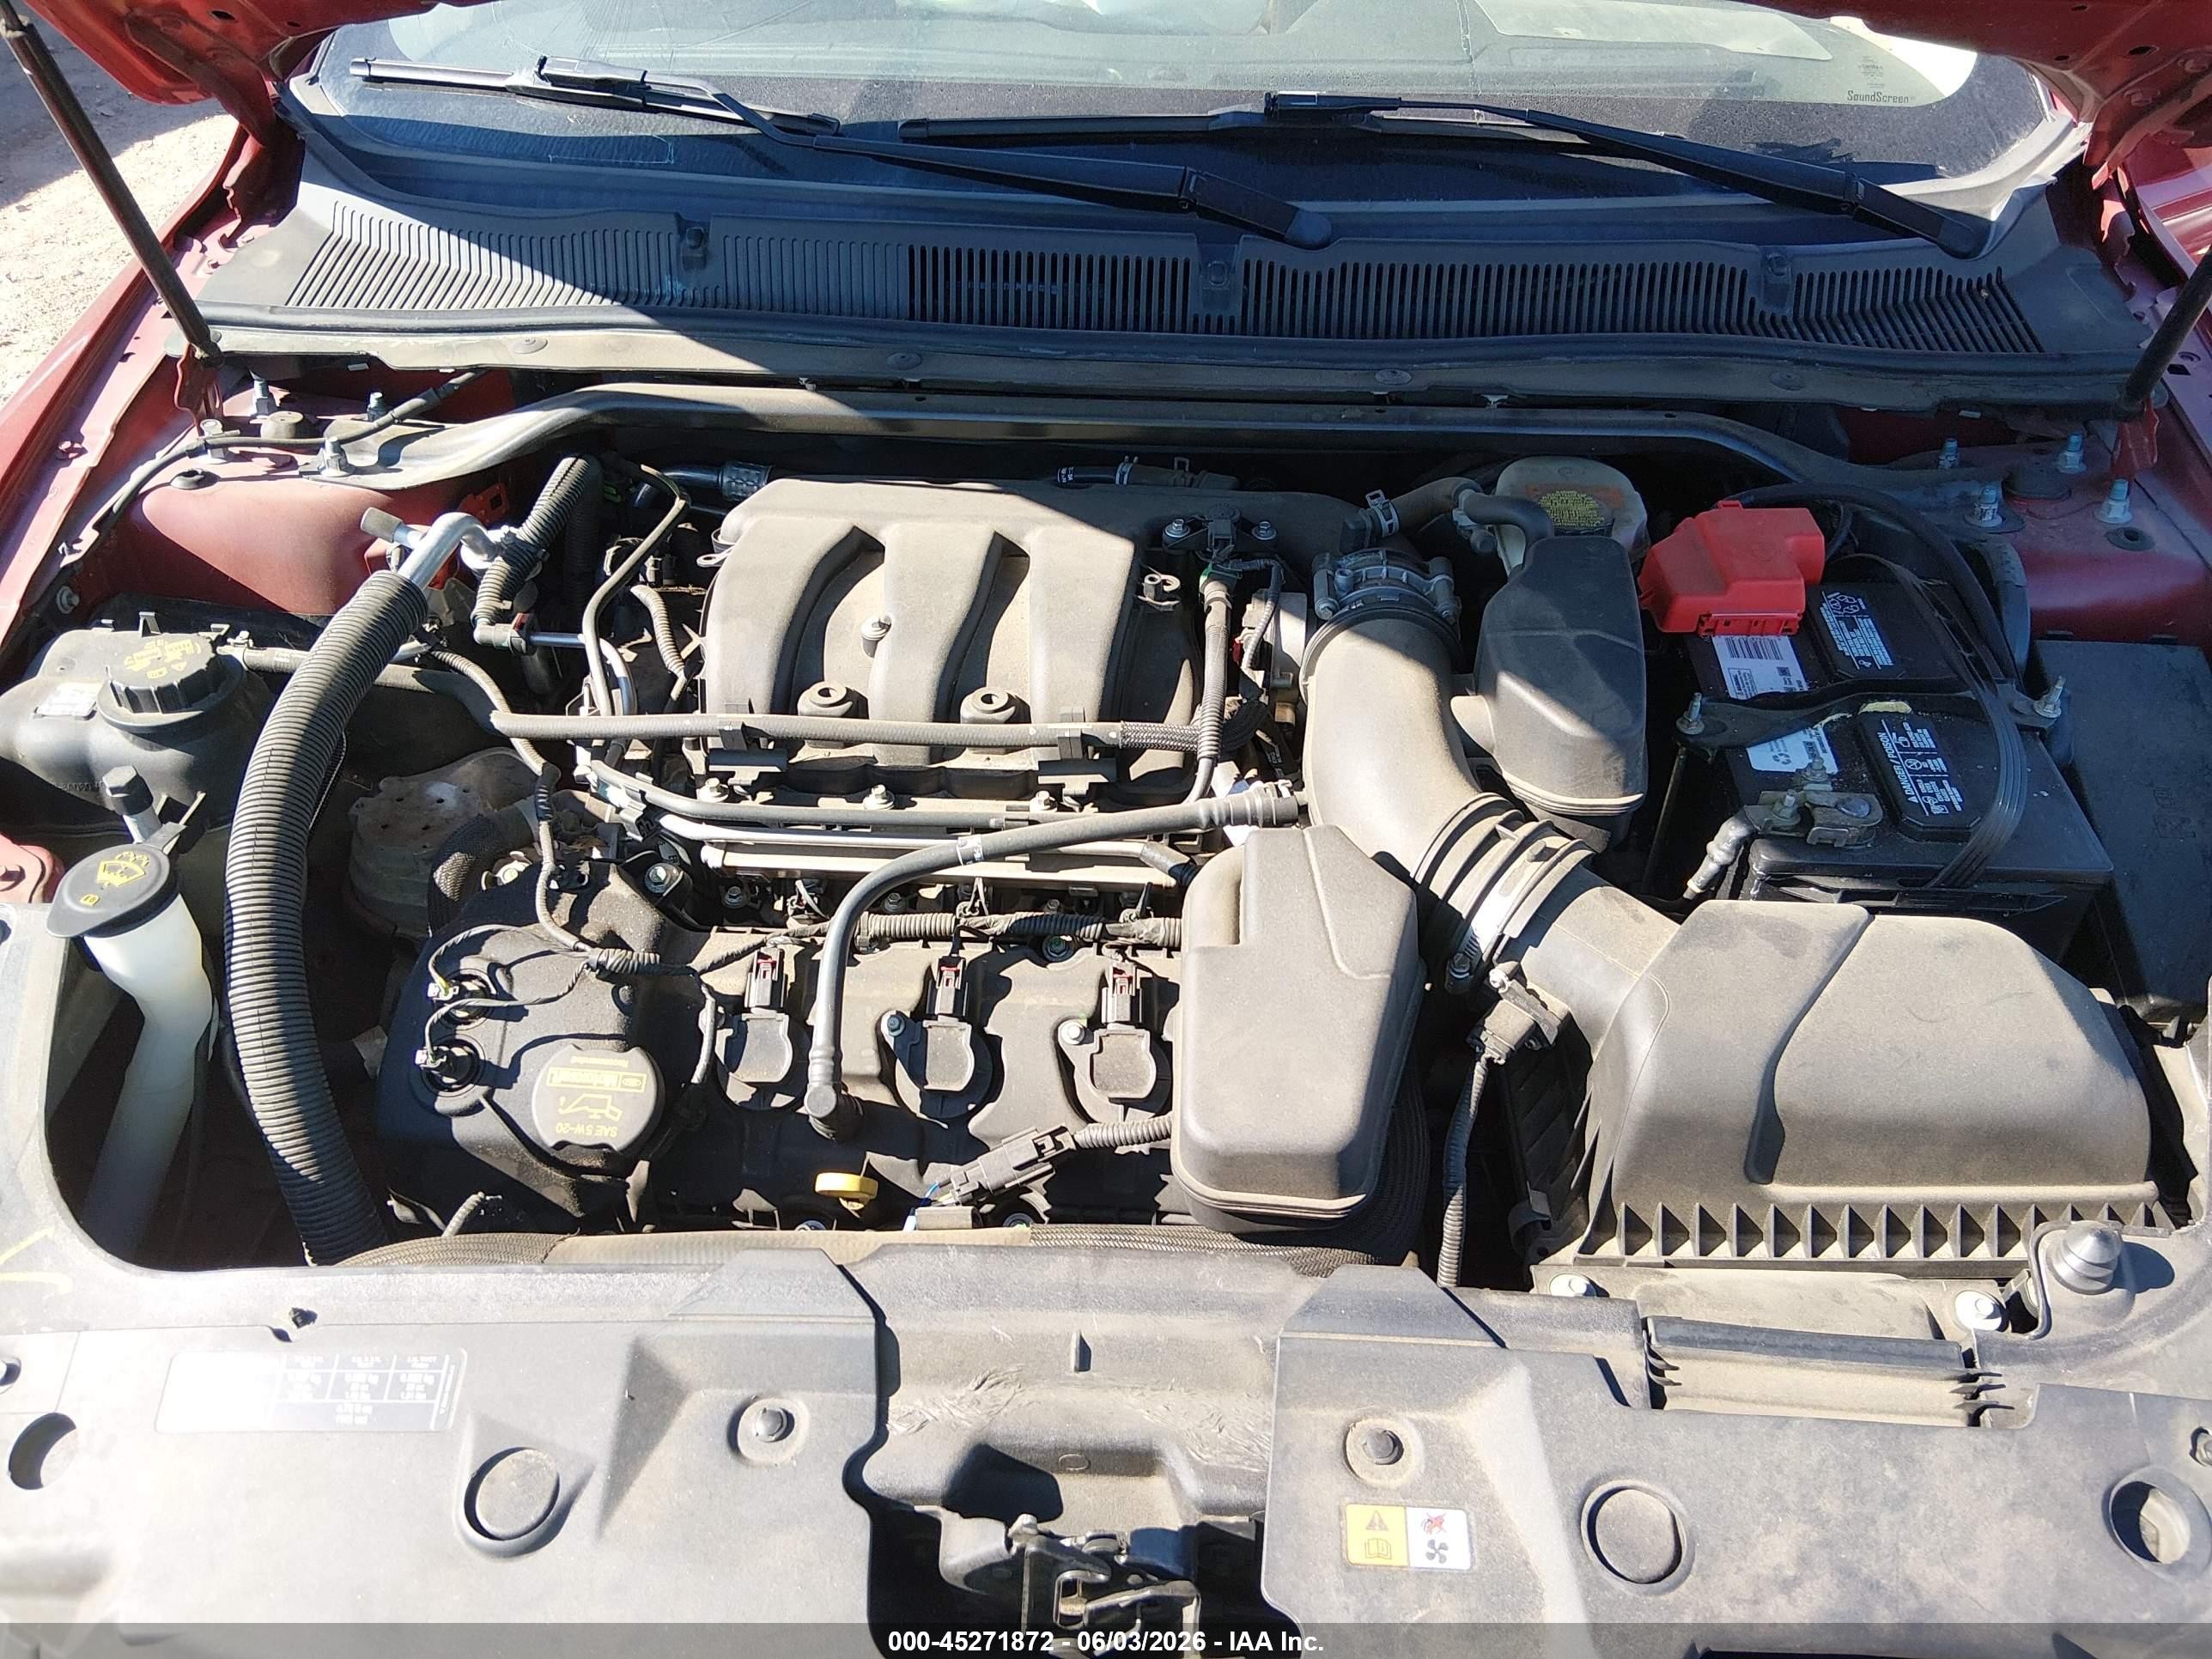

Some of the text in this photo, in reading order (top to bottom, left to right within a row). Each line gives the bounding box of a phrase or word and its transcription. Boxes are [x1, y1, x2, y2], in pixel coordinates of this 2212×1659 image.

[1847, 89, 1909, 104] SoundScreen
[1876, 732, 1898, 758] POISON
[1893, 764, 1915, 795] DANGER
[556, 1122, 618, 1138] SAE 5W-20
